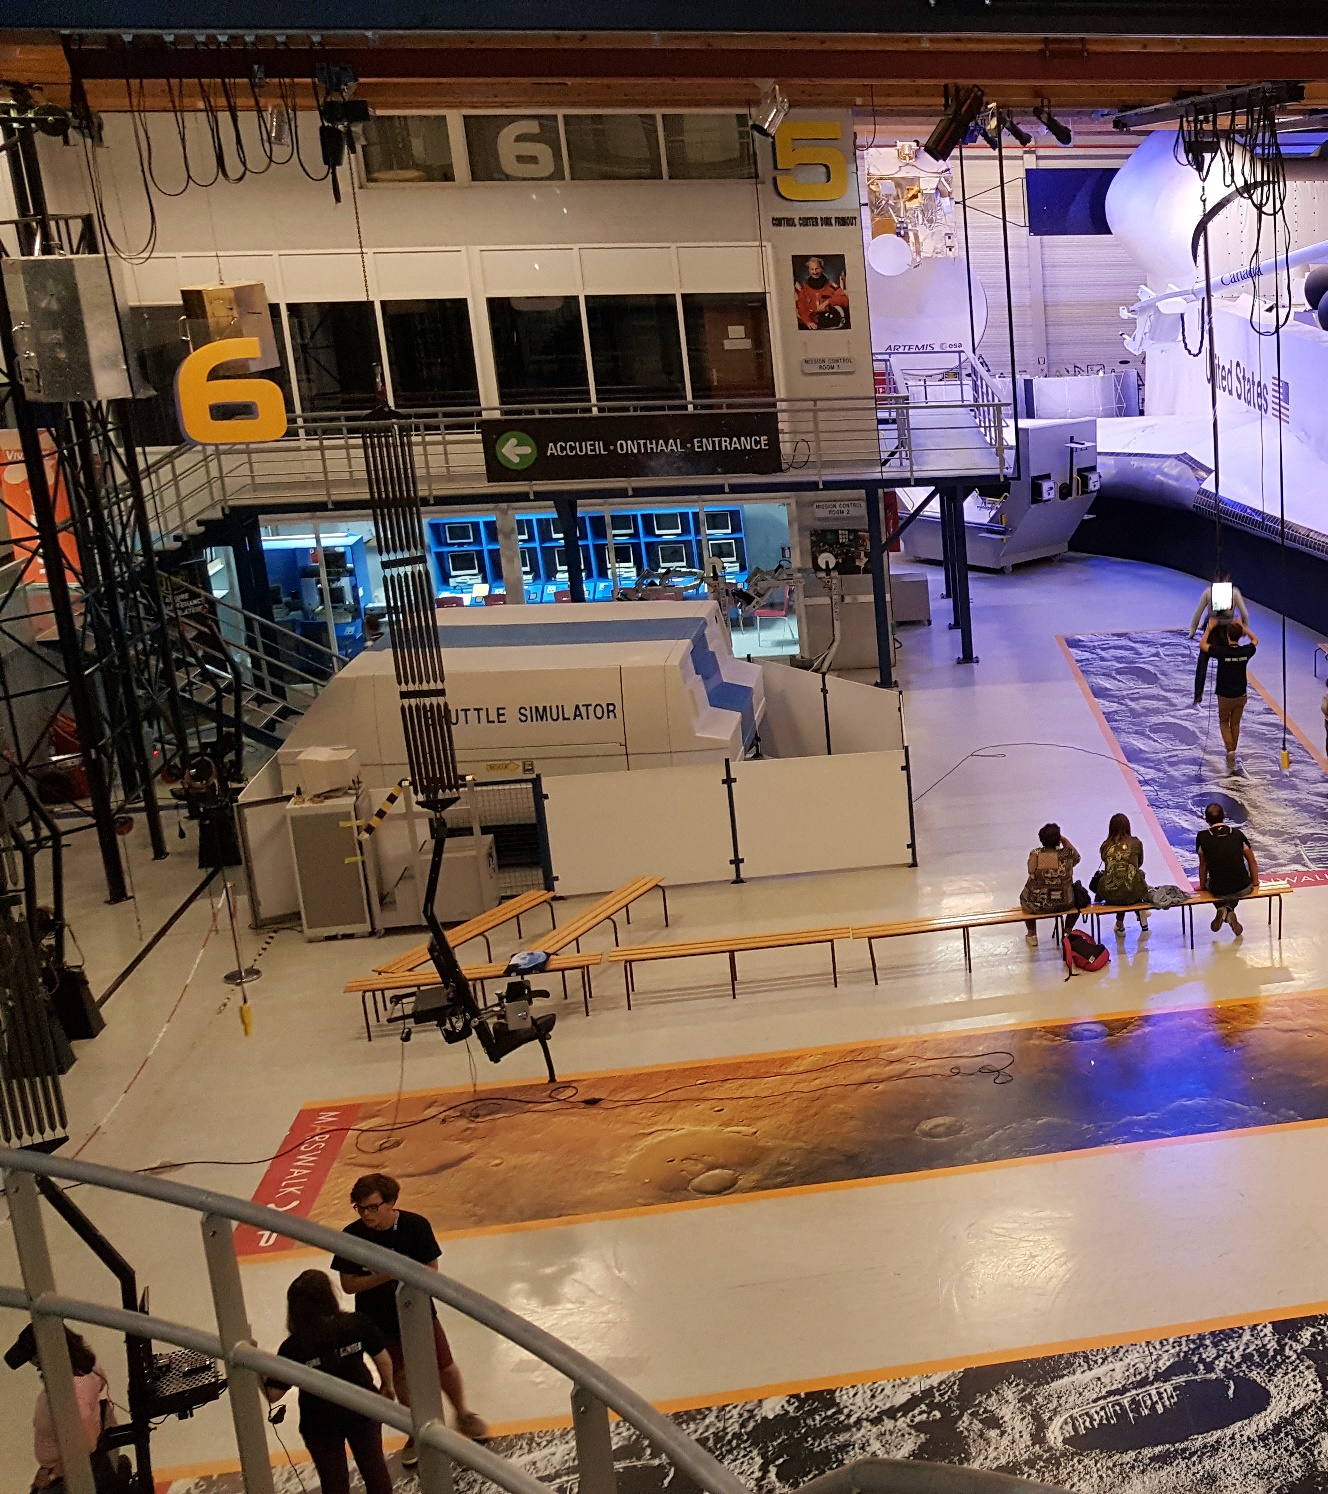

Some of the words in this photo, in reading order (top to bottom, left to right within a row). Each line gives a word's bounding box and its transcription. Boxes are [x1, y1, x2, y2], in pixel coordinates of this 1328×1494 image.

[497, 120, 554, 178] 6
[772, 121, 849, 202] 5
[771, 216, 797, 227] CONTROL
[798, 216, 819, 227] CENTER
[1220, 264, 1264, 286] Canada
[884, 342, 936, 352] ARTEMIS
[173, 336, 288, 446] 6
[1205, 346, 1234, 397] Uited
[1235, 360, 1269, 415] States
[547, 440, 608, 456] ACCUEIL
[616, 438, 685, 454] ONTHAAL
[693, 435, 769, 452] ENTRANCE
[424, 706, 507, 726] UTTLE
[518, 702, 617, 723] SIMULATOR
[275, 1111, 341, 1199] MARSWALK
